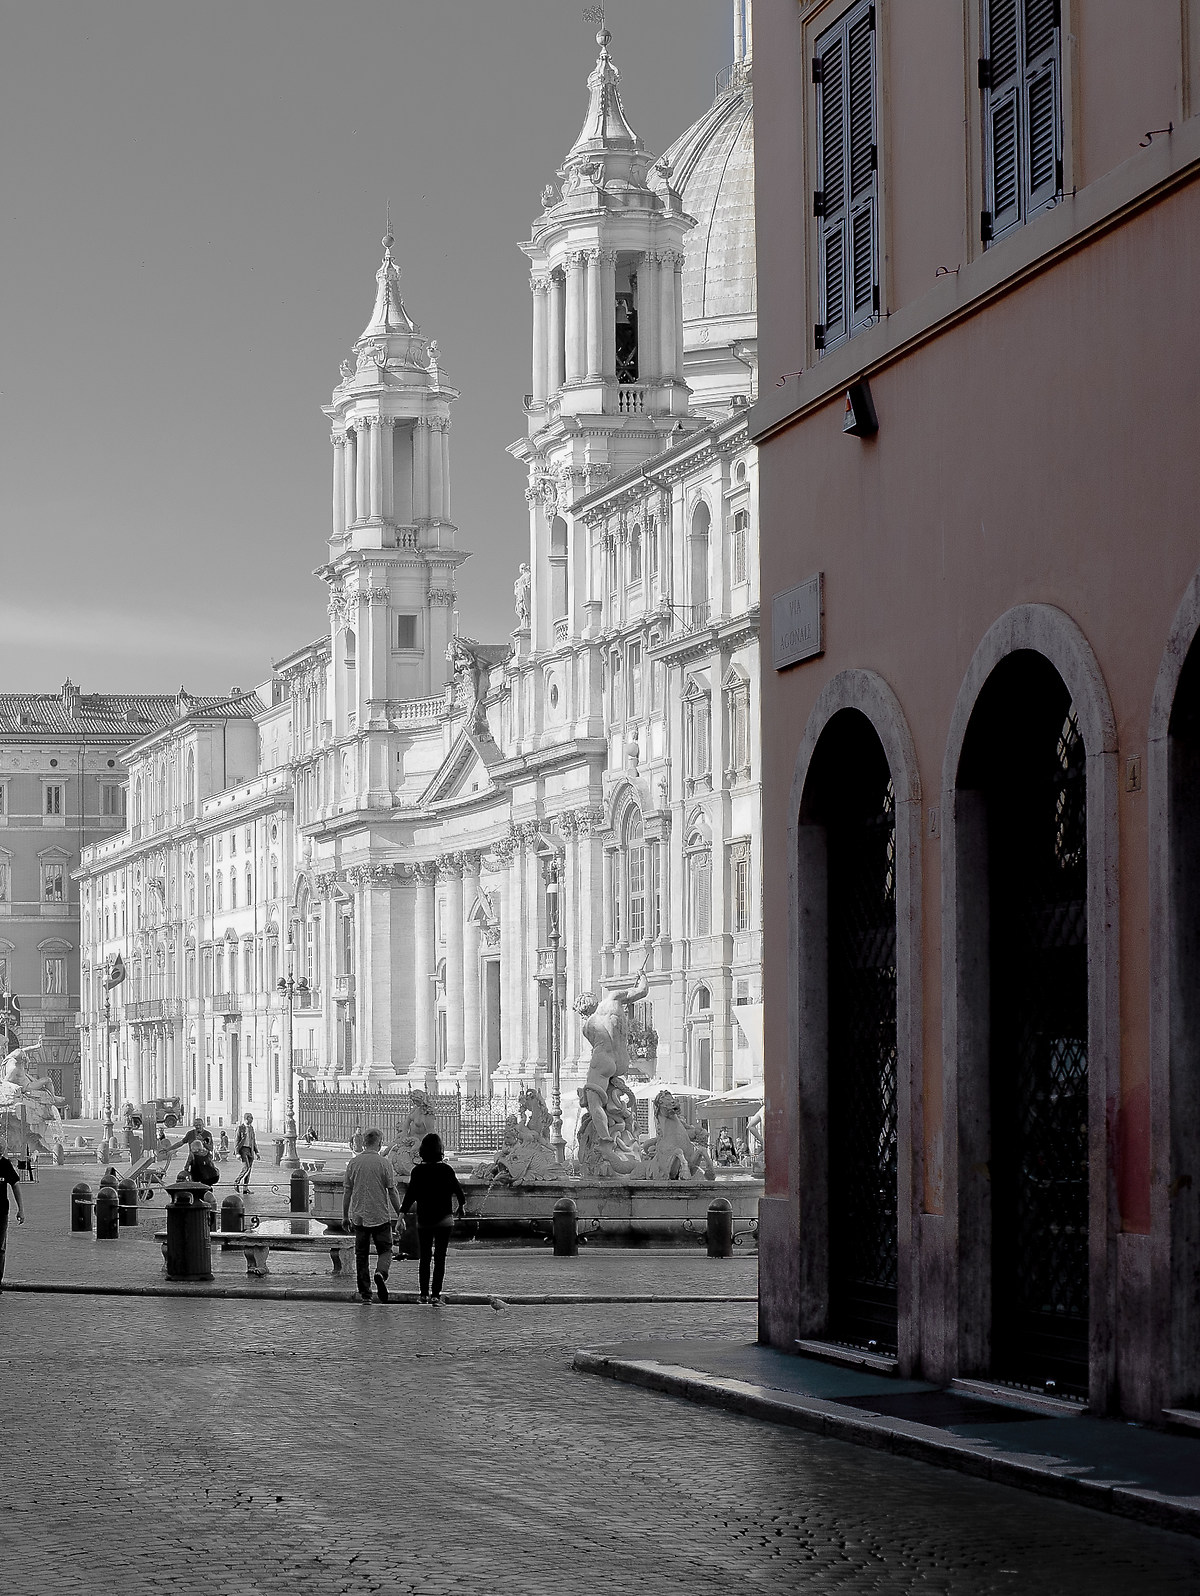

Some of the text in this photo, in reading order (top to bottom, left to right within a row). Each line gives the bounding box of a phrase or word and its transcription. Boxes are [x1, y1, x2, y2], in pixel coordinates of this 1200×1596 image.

[789, 599, 801, 616] VIA
[779, 623, 812, 650] AGONALE
[1129, 764, 1138, 787] 4
